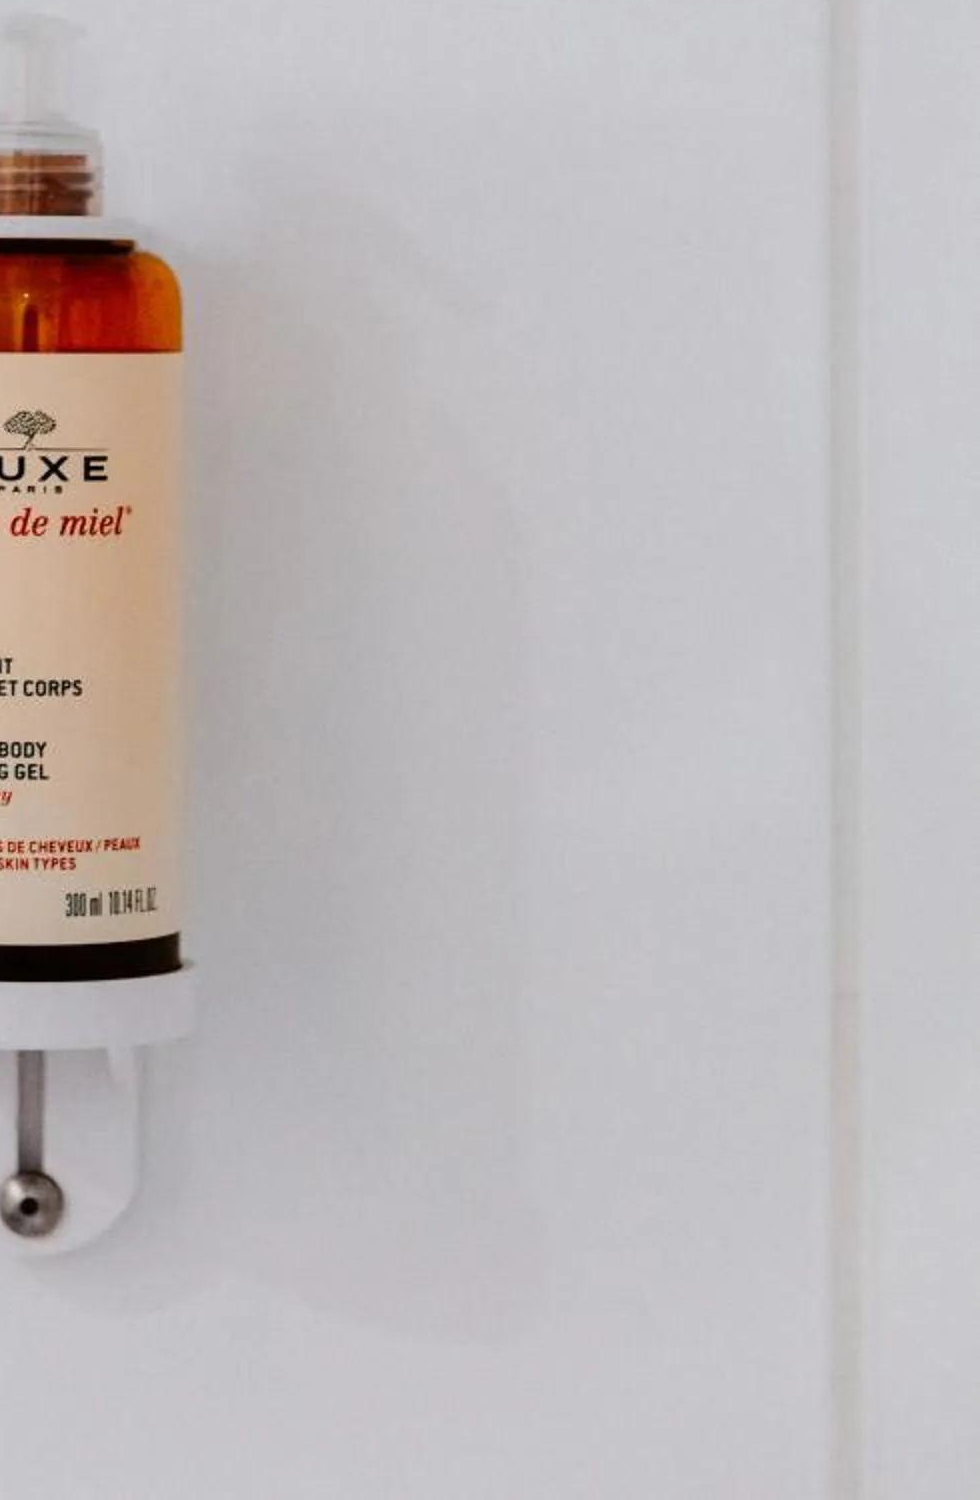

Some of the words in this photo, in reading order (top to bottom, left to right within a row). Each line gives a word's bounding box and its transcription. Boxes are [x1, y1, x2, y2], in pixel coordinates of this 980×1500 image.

[10, 508, 49, 536] de
[23, 680, 83, 697] CORPS
[14, 763, 49, 781] GEL
[8, 840, 25, 853] DE
[29, 839, 93, 853] CHEVEUX
[103, 836, 141, 851] PEAUX
[32, 858, 77, 871] TYPES
[65, 893, 86, 918] 300
[89, 893, 103, 917] ml
